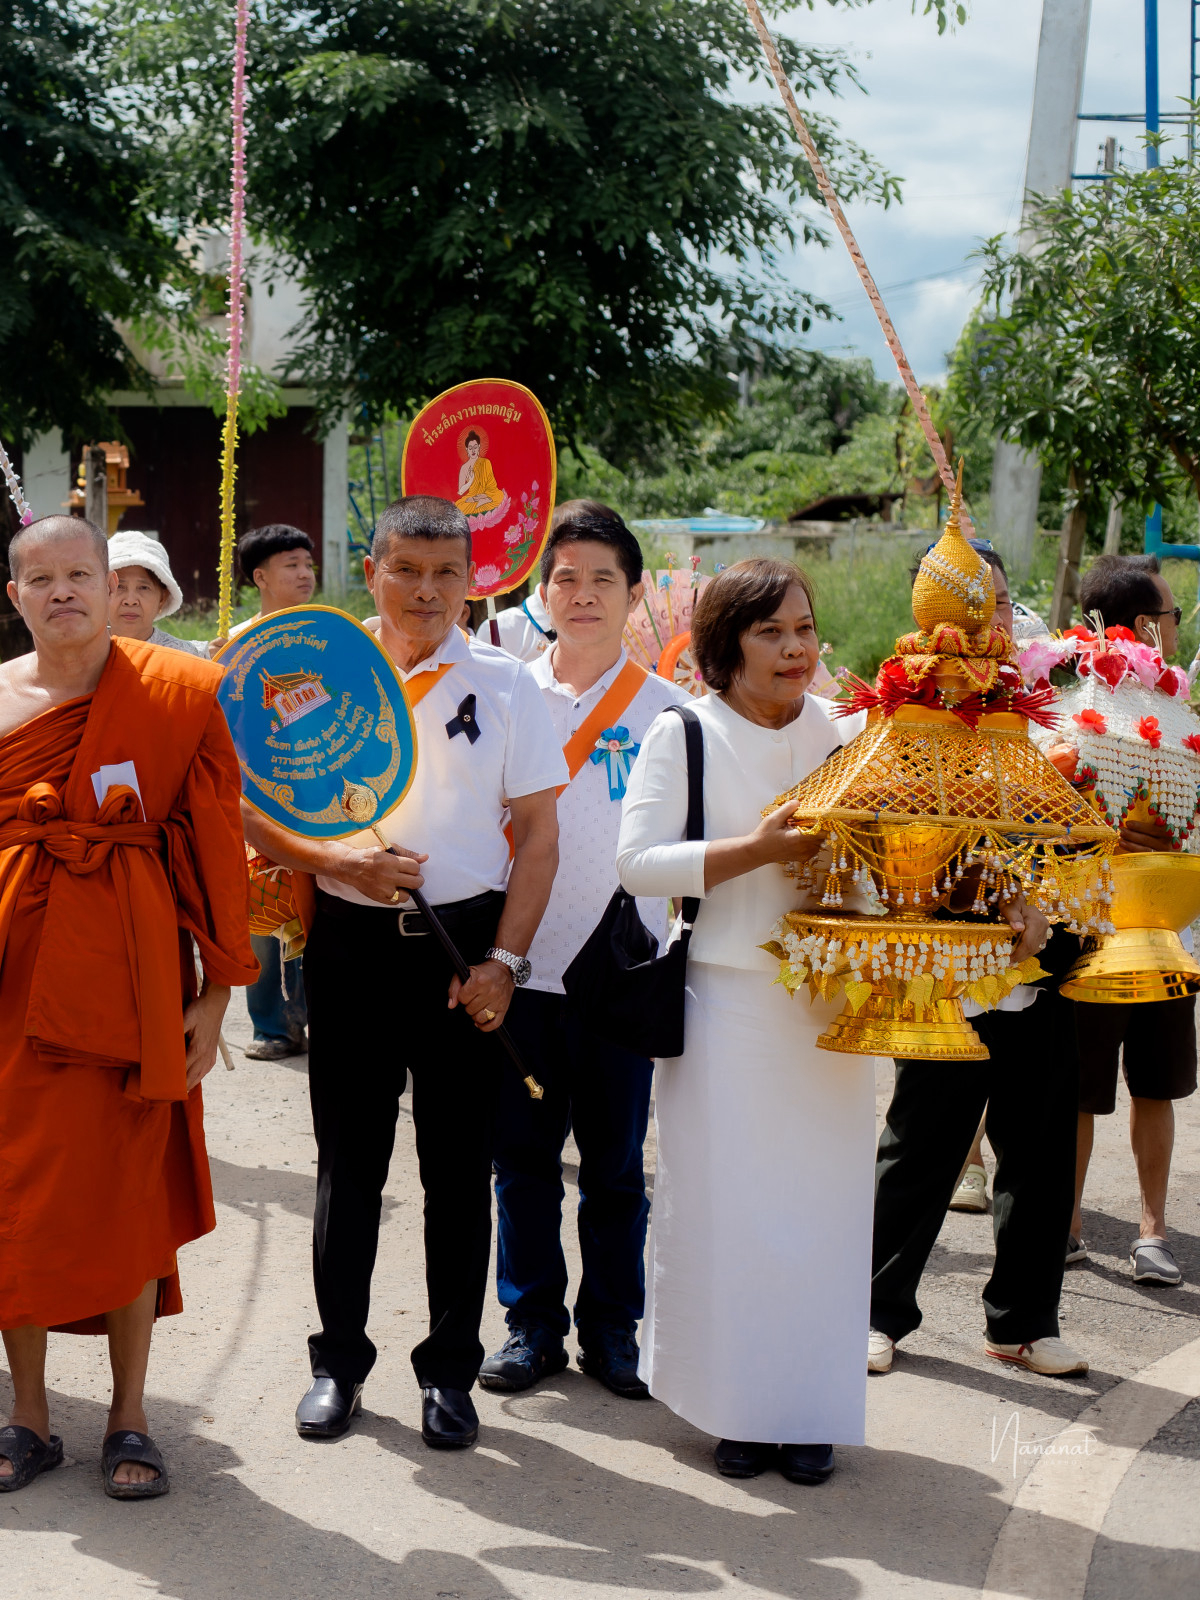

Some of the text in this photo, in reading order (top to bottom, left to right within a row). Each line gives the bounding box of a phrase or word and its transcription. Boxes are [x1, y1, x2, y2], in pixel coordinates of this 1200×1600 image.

[423, 403, 522, 447] ที่ระลึกงานทอดกฐิน
